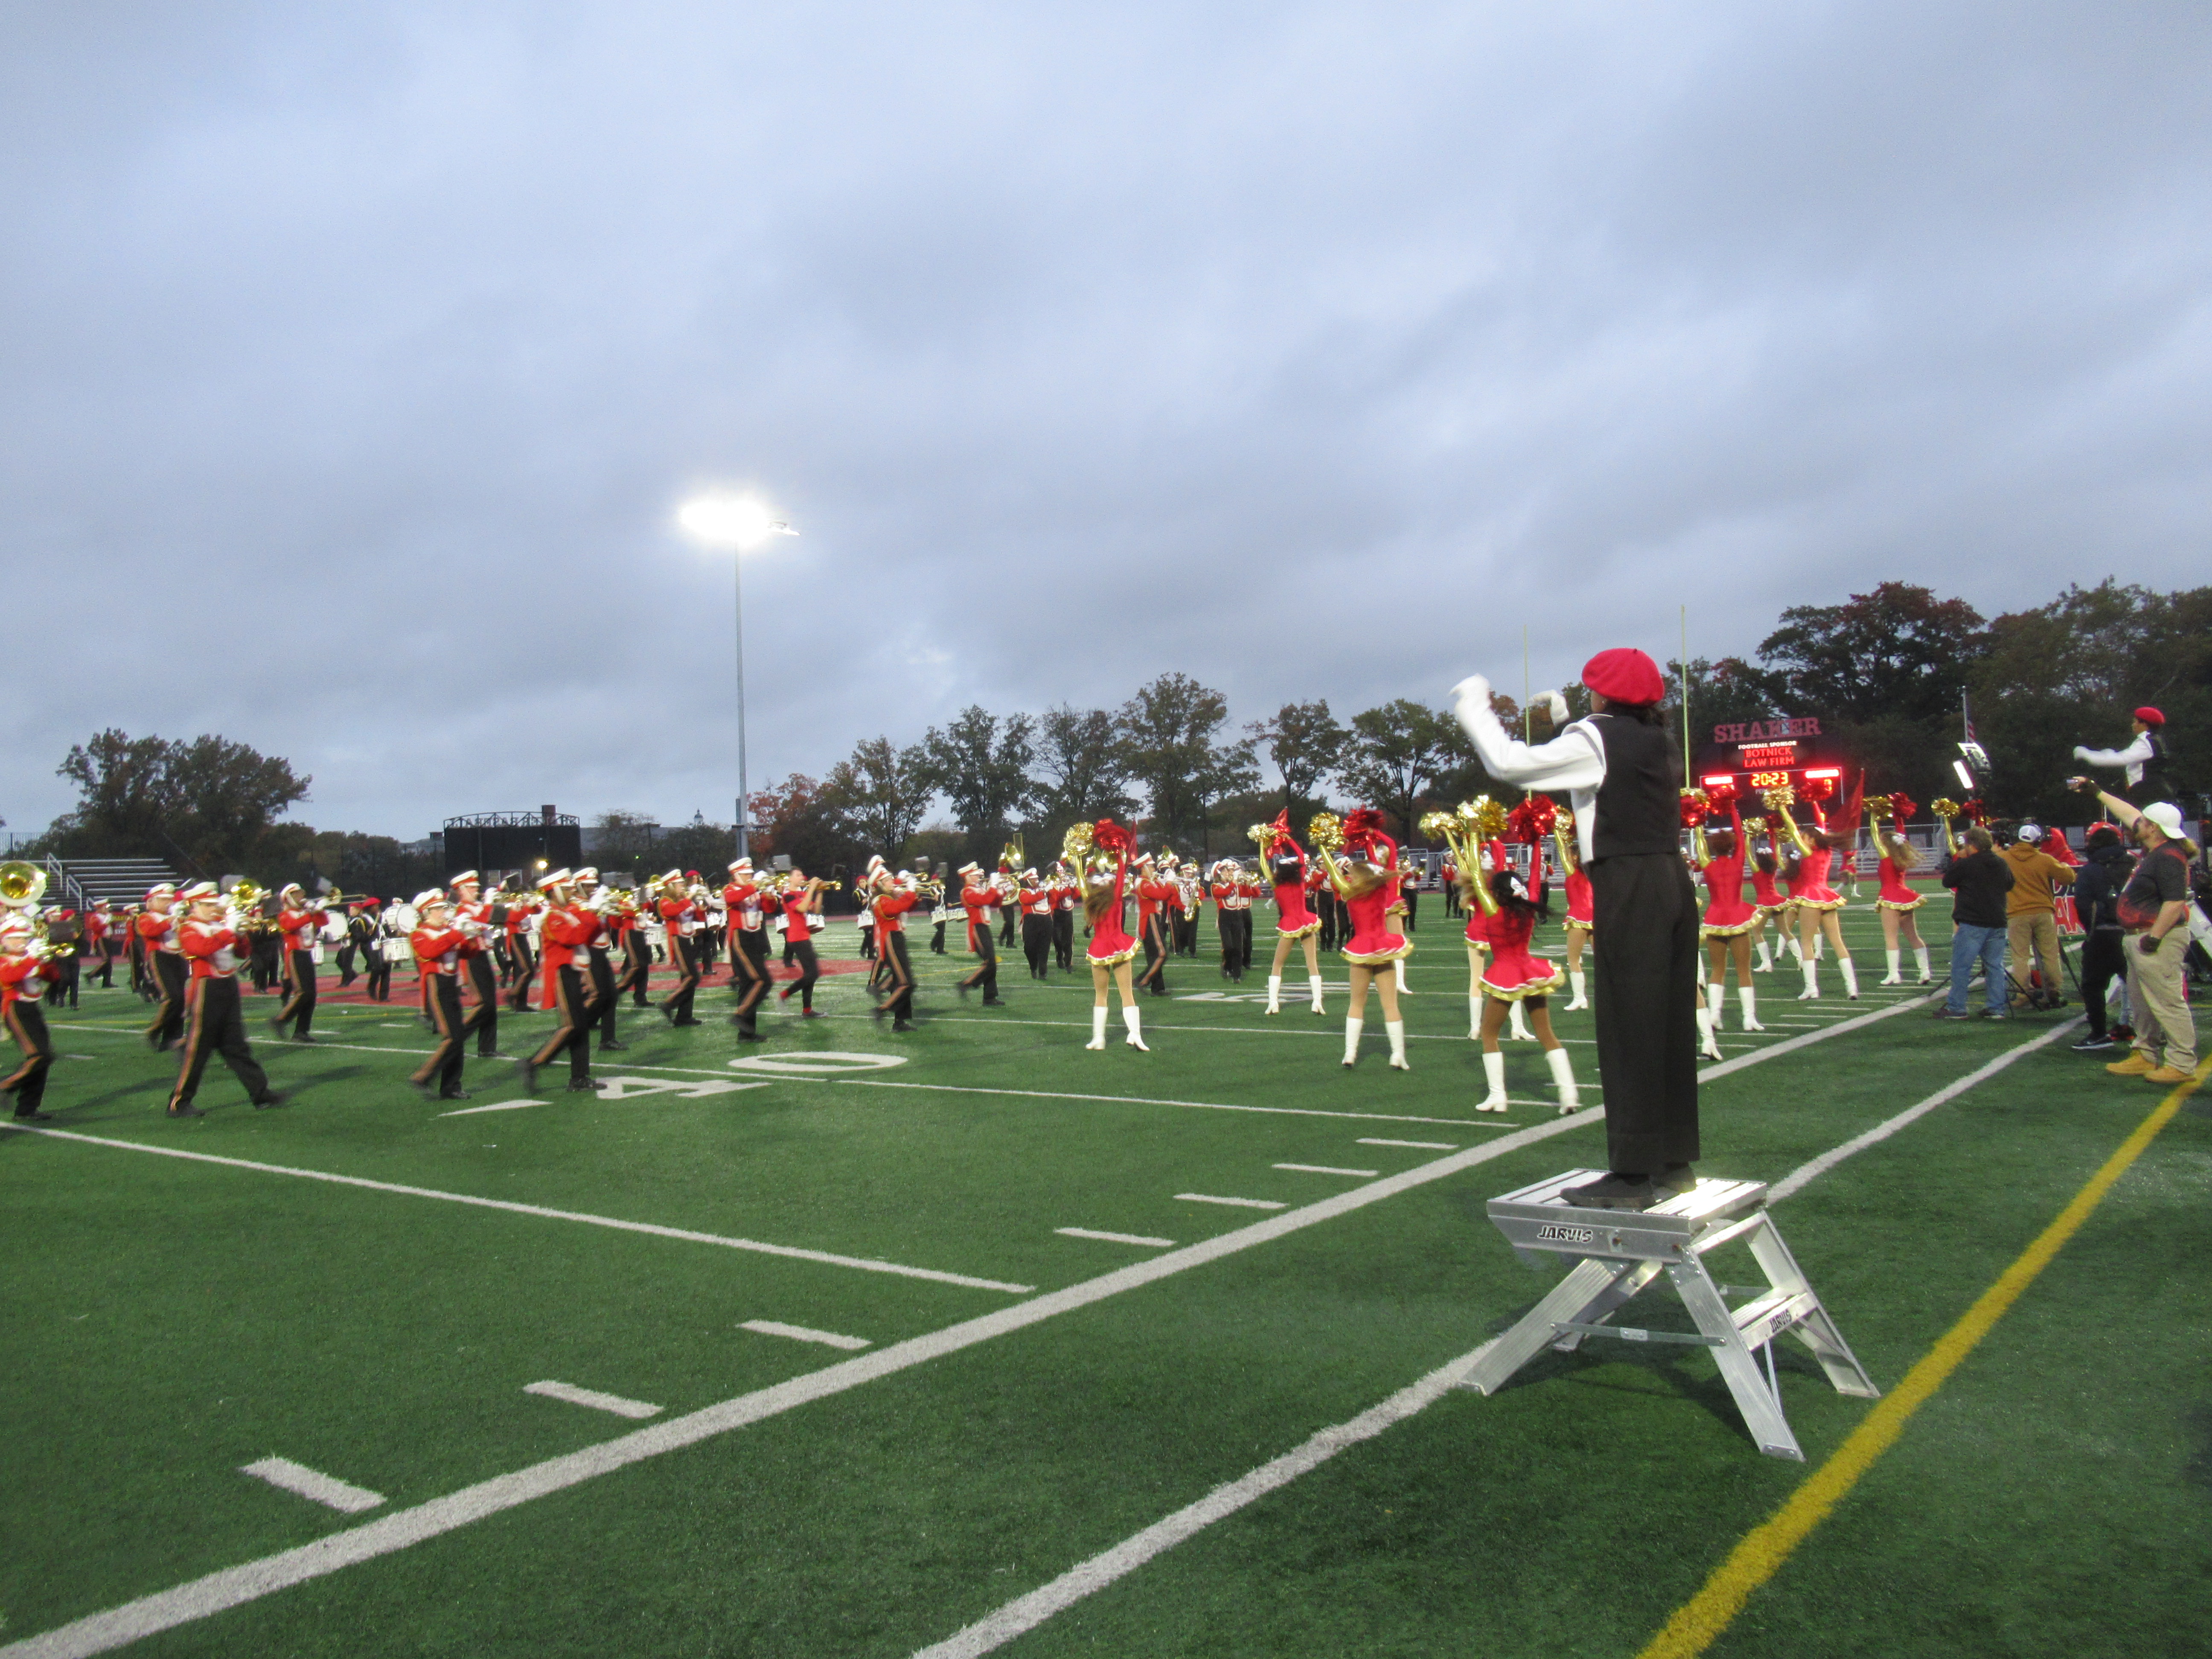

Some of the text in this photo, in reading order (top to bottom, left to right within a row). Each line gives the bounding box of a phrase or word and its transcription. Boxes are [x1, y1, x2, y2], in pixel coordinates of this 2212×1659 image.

[1714, 717, 1822, 743] SHAKER
[1745, 747, 1792, 758] BOTNICK
[1743, 756, 1794, 768] LAW FIRM
[1751, 772, 1788, 786] 20:23
[1537, 1225, 1593, 1243] JARVIS
[1770, 1309, 1792, 1333] JARVIS
